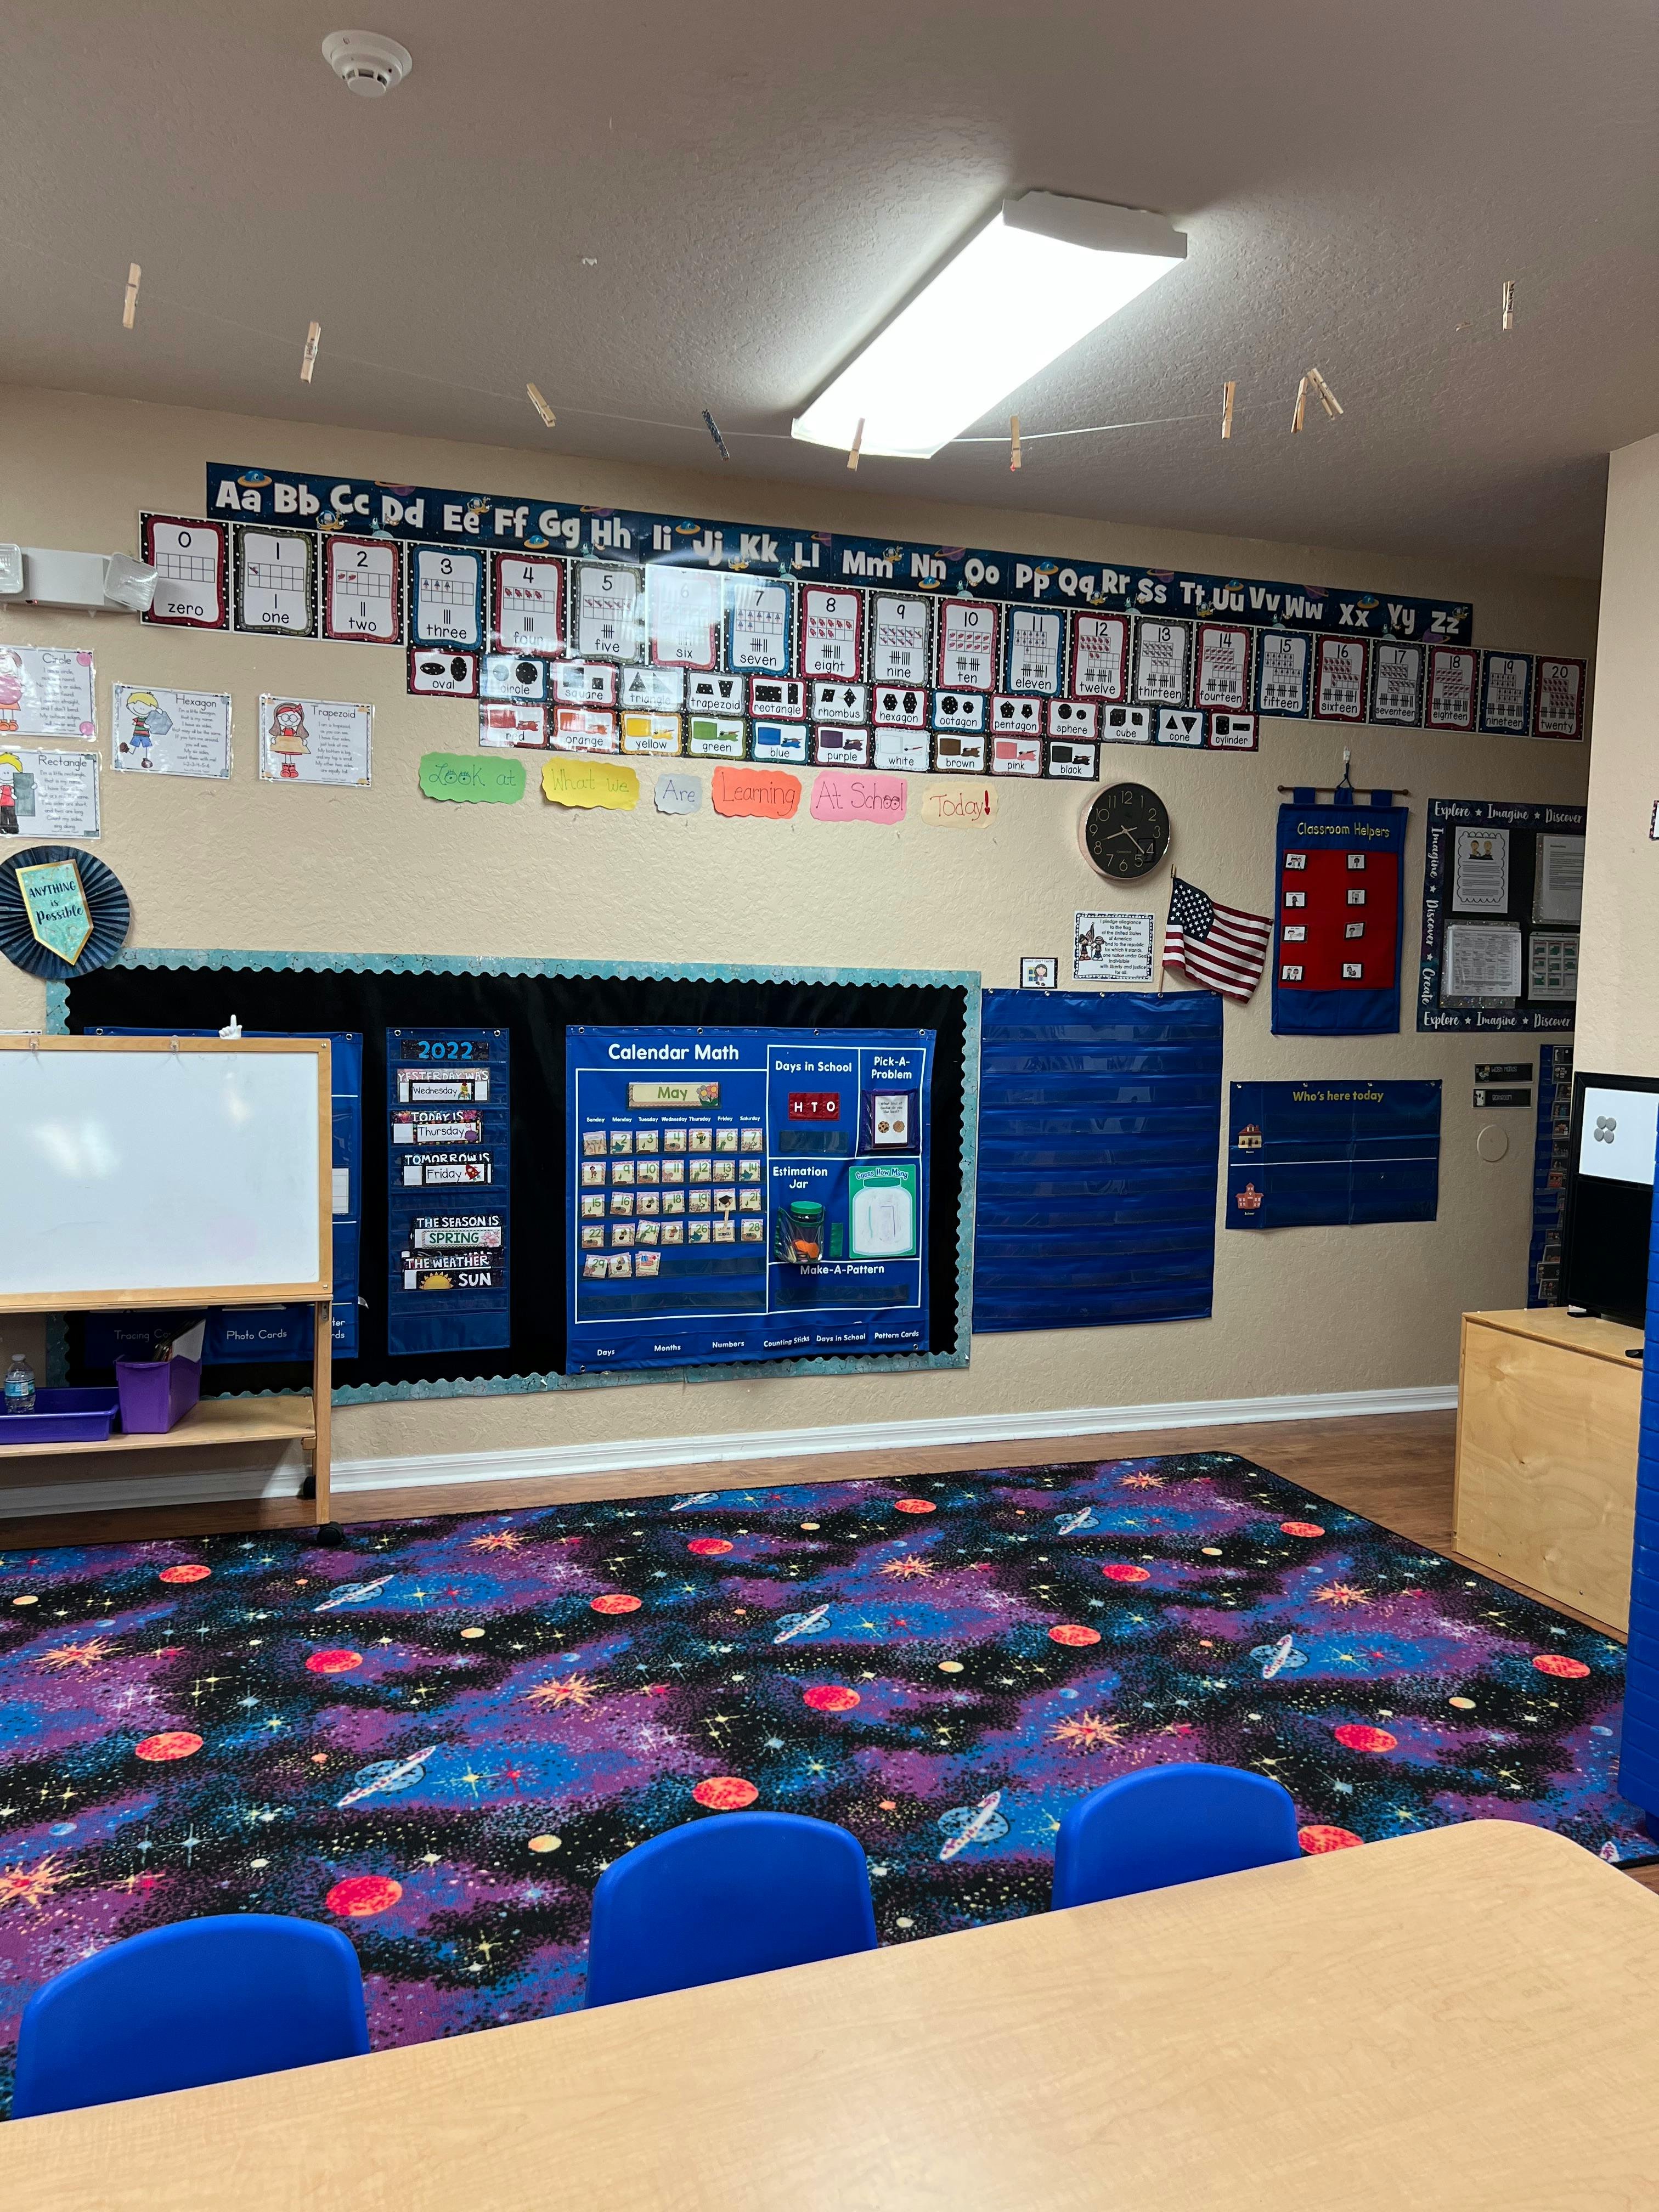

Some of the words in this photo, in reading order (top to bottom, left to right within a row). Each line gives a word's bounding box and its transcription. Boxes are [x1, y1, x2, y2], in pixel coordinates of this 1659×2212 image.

[215, 480, 262, 512] Aa
[274, 483, 320, 516] Bb
[330, 485, 370, 516] Cc
[382, 495, 425, 529] Dd
[443, 505, 481, 534] Ee
[494, 507, 529, 538] Ff
[538, 509, 581, 549] Gg
[590, 516, 632, 549] Hh
[692, 530, 724, 566] Jj
[739, 533, 779, 563] Kk
[842, 550, 893, 579] Mm
[911, 553, 947, 580] Nn
[964, 557, 1000, 585] Oo
[1015, 563, 1050, 599] Pp
[1058, 568, 1095, 602] Qq
[1101, 569, 1130, 595] Rr
[1137, 578, 1167, 604] Ss
[1179, 581, 1205, 605] Tt
[1211, 587, 1244, 612] Uu
[1248, 586, 1281, 611] Vv
[1284, 595, 1323, 620] Ww
[1339, 603, 1369, 628] Xx
[1387, 603, 1415, 635] Yy
[1430, 611, 1460, 634] Zz
[357, 551, 369, 568] 2
[167, 603, 204, 616] zero
[262, 612, 289, 624] one
[348, 614, 377, 633] two
[964, 612, 979, 627] 10
[426, 623, 467, 640] three
[595, 639, 620, 653] five
[42, 653, 71, 664] Circle
[740, 654, 777, 667] seven
[814, 659, 845, 676] eight
[887, 667, 911, 678] nine
[957, 671, 977, 684] ten
[432, 679, 455, 691] oval
[500, 684, 531, 696] circle
[1015, 679, 1052, 691] eleven
[1080, 681, 1115, 695] twelve
[565, 689, 604, 701] square
[1138, 685, 1182, 699] thirteen
[1199, 689, 1243, 704] fourteen
[176, 693, 217, 711] Hexagon
[690, 697, 741, 710] trapezoid
[1263, 695, 1300, 709] fifteen
[1321, 700, 1358, 714] sixteen
[311, 705, 356, 721] Trapezoid
[754, 704, 802, 715] rectangle
[818, 707, 860, 719] rhombus
[1432, 708, 1468, 724] eighteen
[879, 711, 918, 724] hexagon
[939, 717, 978, 728] octagon
[994, 720, 1037, 732] pentagon
[1056, 724, 1088, 736] sphere
[1541, 719, 1573, 733] twenty
[1116, 729, 1137, 738] cube
[1169, 733, 1190, 742] cone
[1215, 734, 1248, 746] cylinder
[565, 735, 603, 748] orange
[635, 738, 667, 750] yellow
[702, 742, 732, 754] green
[769, 748, 790, 758] blue
[827, 752, 857, 762] purple
[38, 754, 87, 771] Rectangle
[888, 755, 915, 766] white
[945, 758, 975, 768] brown
[1007, 761, 1025, 771] pink
[1060, 764, 1082, 775] black
[496, 770, 517, 787] at
[551, 769, 595, 791] What
[662, 780, 696, 803] Are
[721, 771, 795, 816] Learning
[815, 781, 842, 810] At
[851, 782, 904, 811] School
[1121, 791, 1133, 804] 12
[1096, 808, 1110, 822] 10
[1434, 801, 1470, 818] Explore
[1487, 804, 1529, 823] Imagine
[1545, 808, 1584, 823] Discover
[1297, 822, 1350, 836] Classroom
[1354, 822, 1390, 840] Helpers
[29, 881, 76, 898] ANYTHING
[1421, 968, 1435, 1005] Create
[418, 1041, 473, 1059] 2022
[608, 1043, 690, 1060] Calendar
[695, 1043, 739, 1060] Math
[775, 1060, 802, 1073] Days
[805, 1061, 814, 1071] in
[817, 1062, 852, 1072] School
[874, 1056, 910, 1066] Pick-A-
[465, 1070, 489, 1081] WAS
[871, 1069, 912, 1079] Problem
[413, 1086, 457, 1097] Wednesday
[658, 1087, 688, 1101] May
[1293, 1091, 1325, 1102] Who's
[1327, 1091, 1351, 1101] here
[1352, 1090, 1384, 1103] today
[411, 1112, 450, 1121] TODAY
[453, 1111, 464, 1120] IS
[417, 1126, 465, 1138] Thursday
[404, 1154, 476, 1165] TOMORROW
[478, 1153, 490, 1161] IS
[427, 1169, 462, 1182] Friday
[772, 1166, 828, 1177] Estimation
[856, 1171, 874, 1180] Guess
[891, 1169, 909, 1180] Many
[789, 1179, 809, 1189] Jar
[416, 1217, 439, 1228] THE
[442, 1216, 486, 1227] SEASON
[488, 1215, 499, 1226] IS
[748, 1223, 760, 1232] 28
[429, 1232, 479, 1244] SPRING
[589, 1229, 601, 1238] 22
[405, 1258, 430, 1269] THE
[432, 1255, 490, 1268] WEATHER
[800, 1265, 884, 1274] Make-A-Pattern
[458, 1272, 492, 1287] SUN
[227, 1330, 255, 1340] Photo
[258, 1329, 287, 1339] Cards
[816, 1335, 834, 1343] Days
[899, 1330, 919, 1338] Cards
[654, 1344, 681, 1352] Months
[712, 1340, 745, 1348] Numbers
[763, 1339, 793, 1348] Counting
[793, 1335, 810, 1344] Sticks
[597, 1348, 615, 1357] Days
